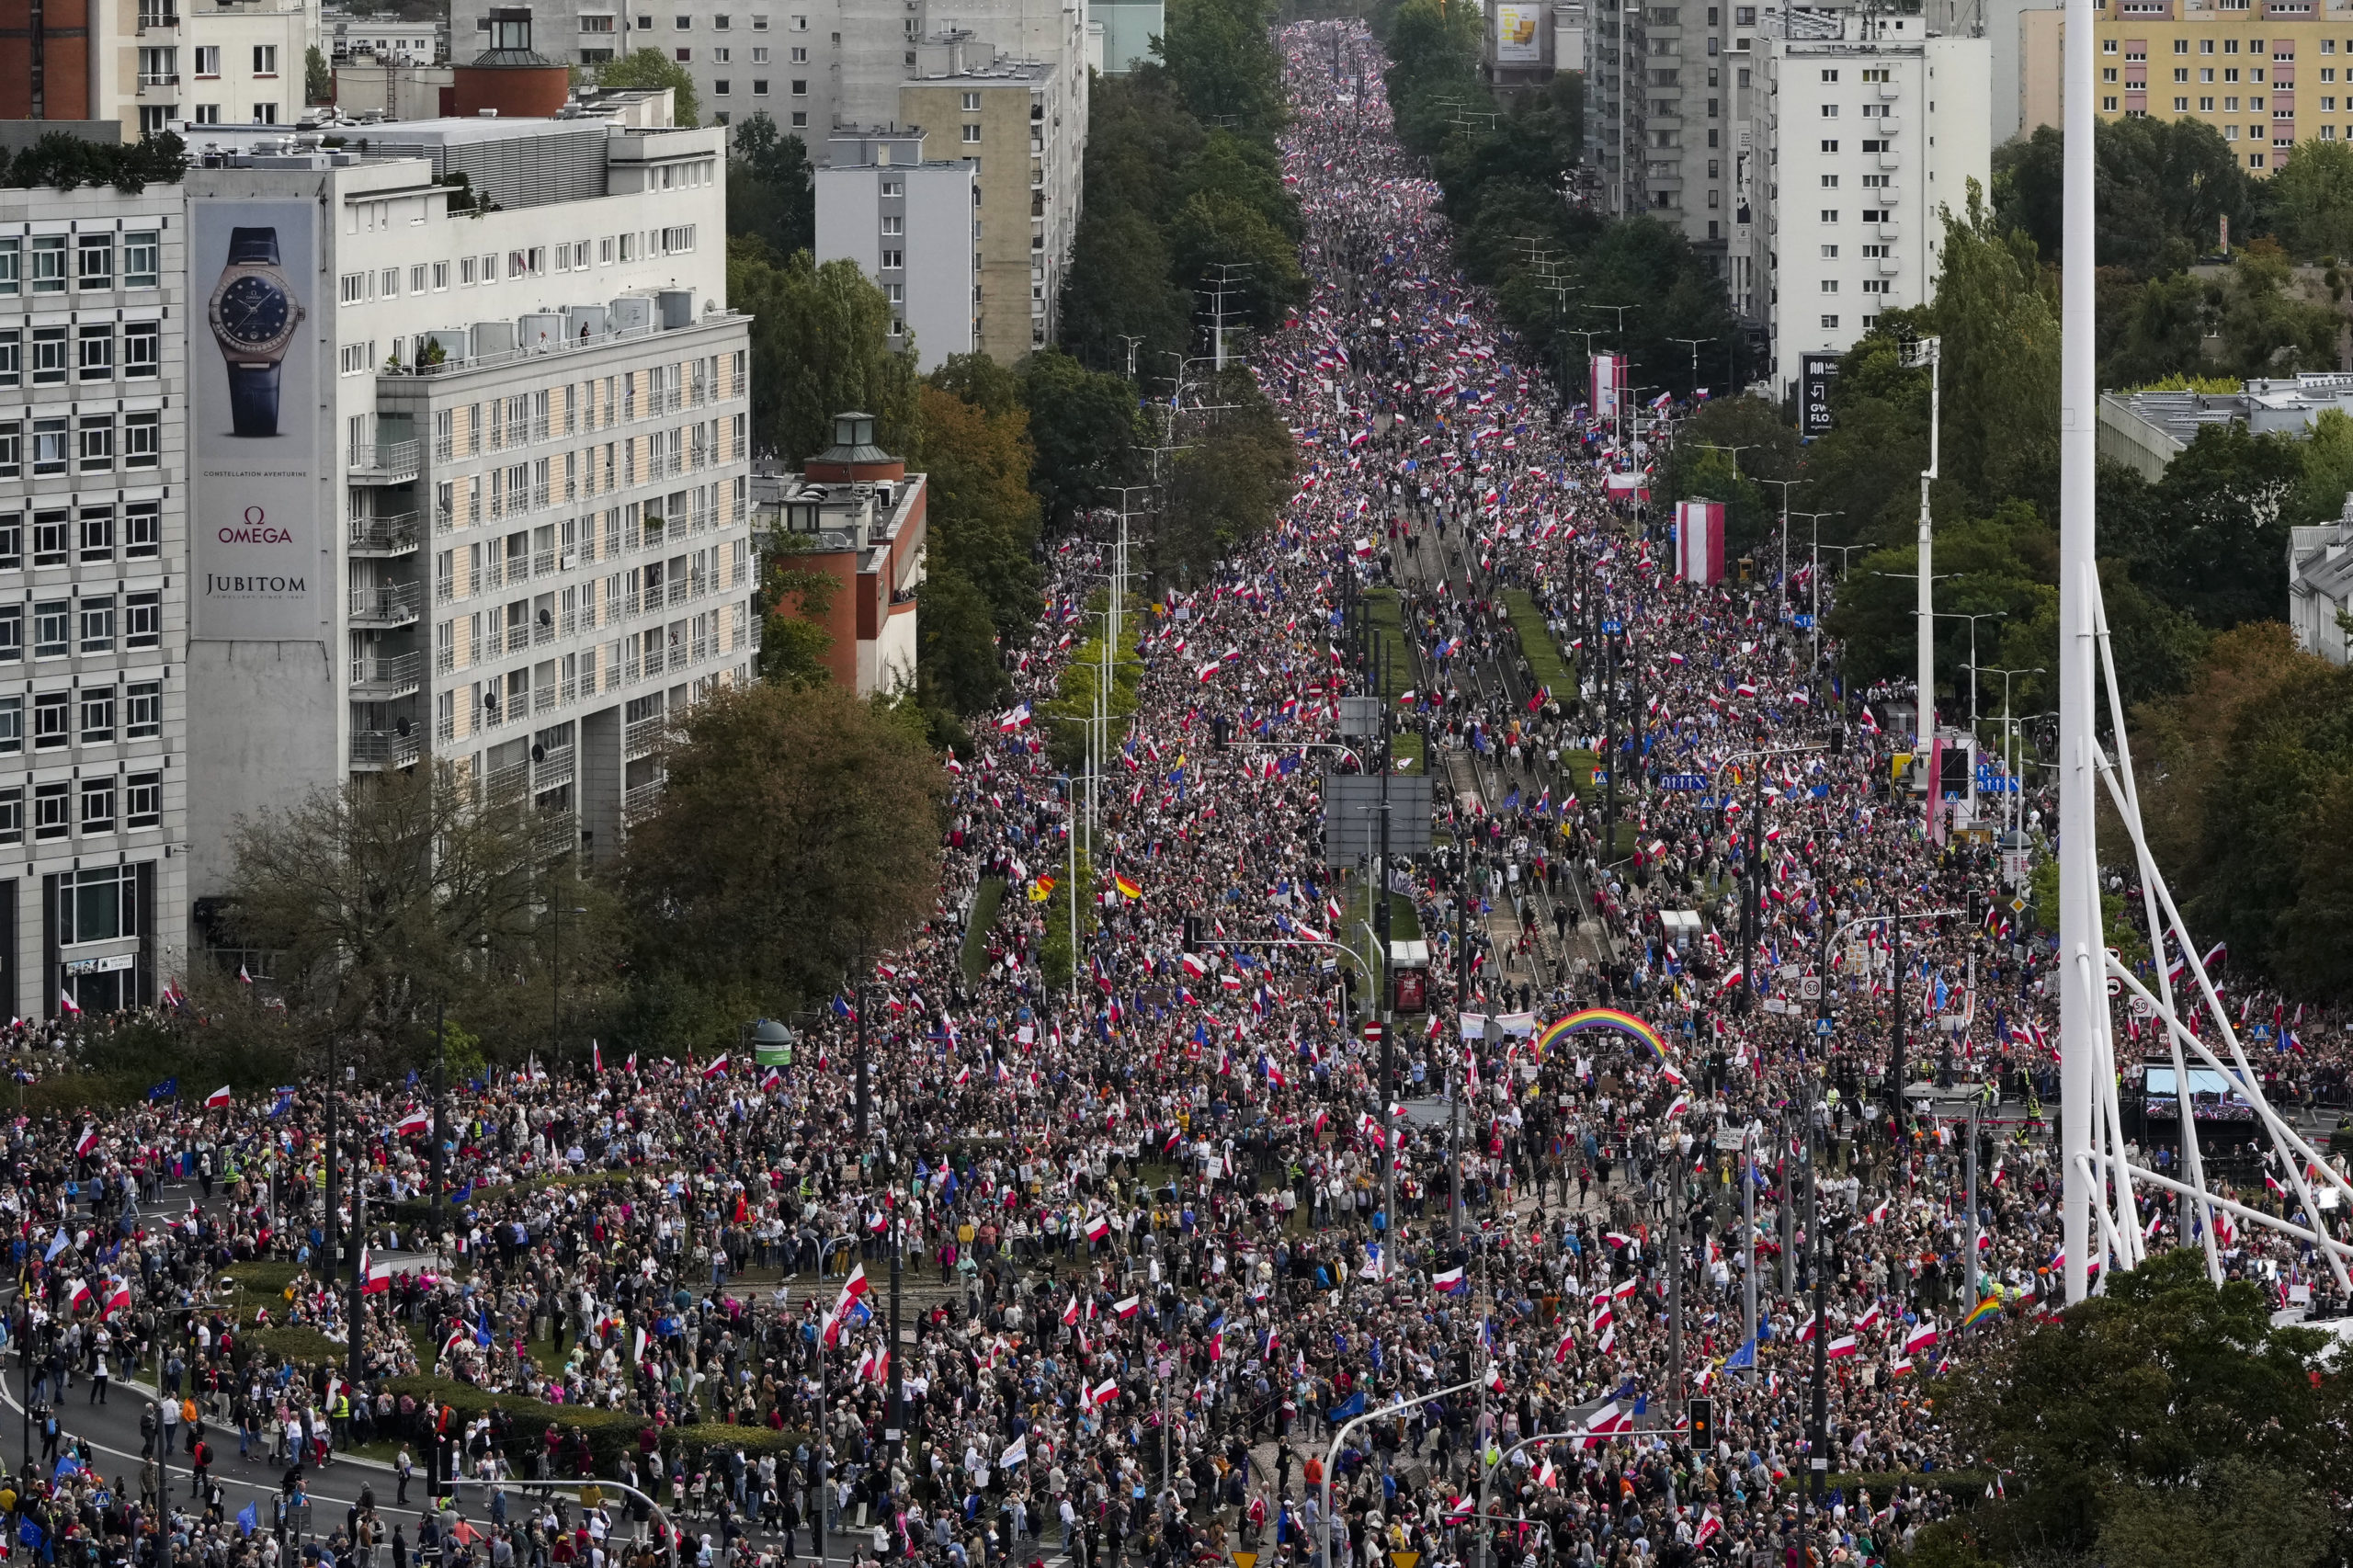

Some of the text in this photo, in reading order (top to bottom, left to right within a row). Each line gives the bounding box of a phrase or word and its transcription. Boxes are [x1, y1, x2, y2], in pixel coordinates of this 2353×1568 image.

[219, 528, 293, 543] OMEGA
[206, 574, 307, 596] JUBITOM
[2135, 1002, 2146, 1010] 50
